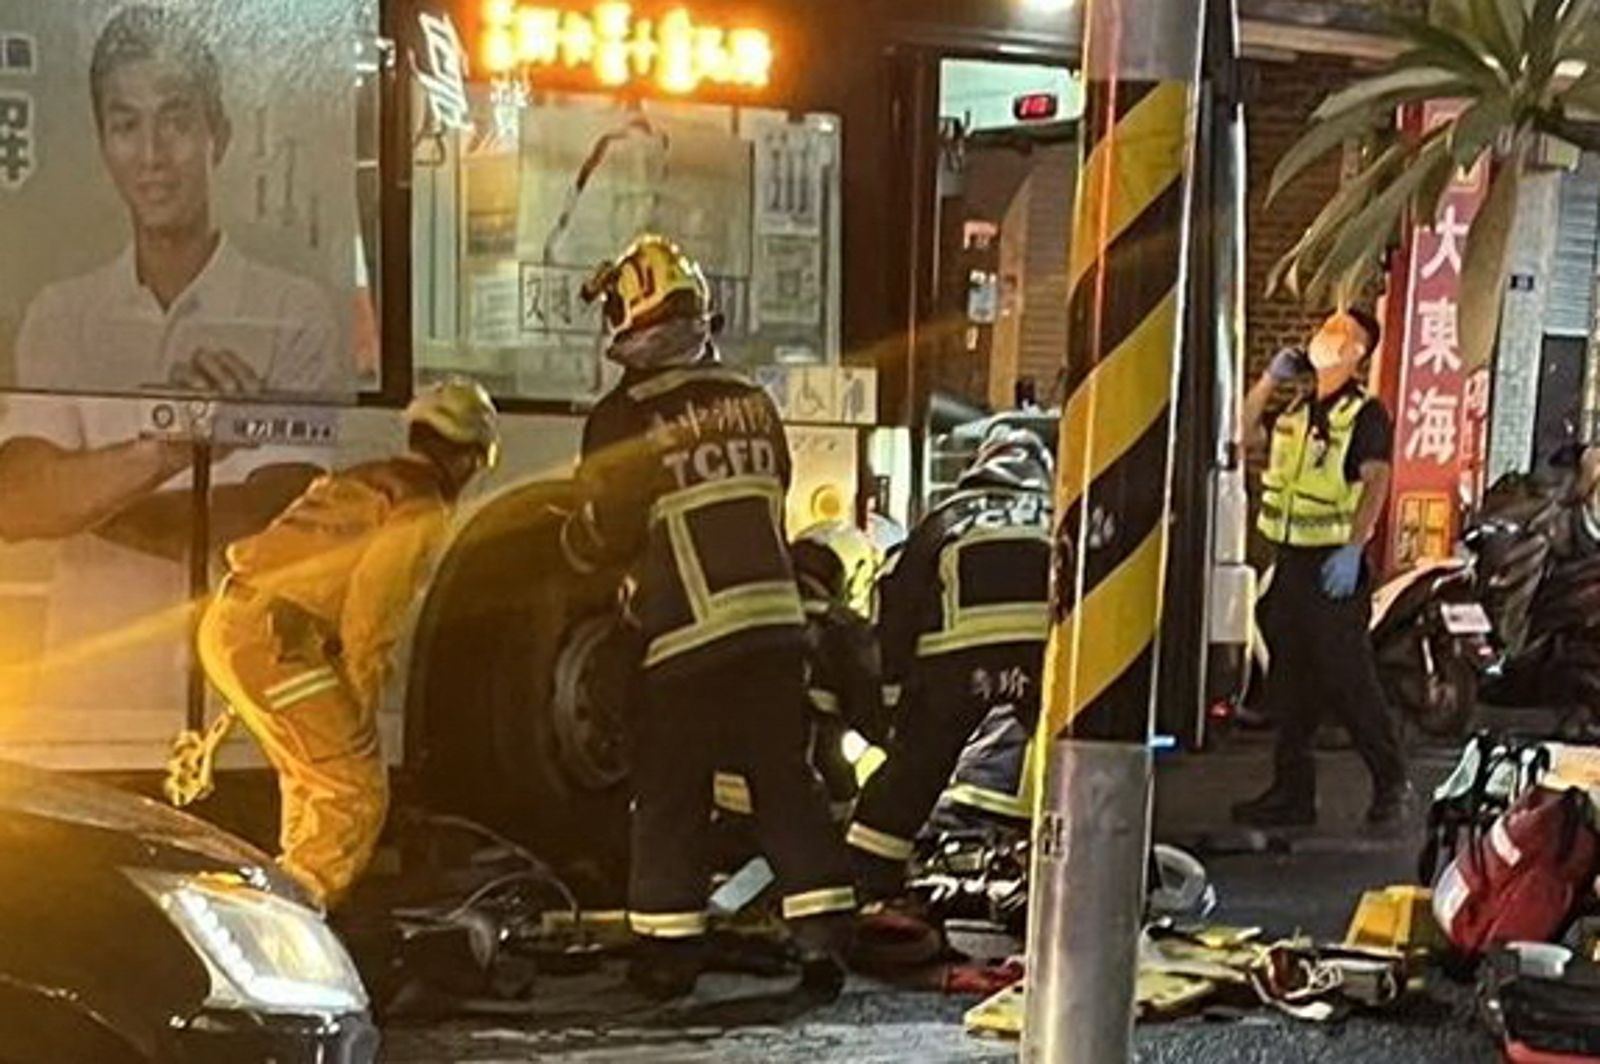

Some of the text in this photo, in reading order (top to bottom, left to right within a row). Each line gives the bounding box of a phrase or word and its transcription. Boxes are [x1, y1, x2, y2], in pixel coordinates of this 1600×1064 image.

[1405, 205, 1468, 465] 大東海
[663, 439, 777, 488] TCFD
